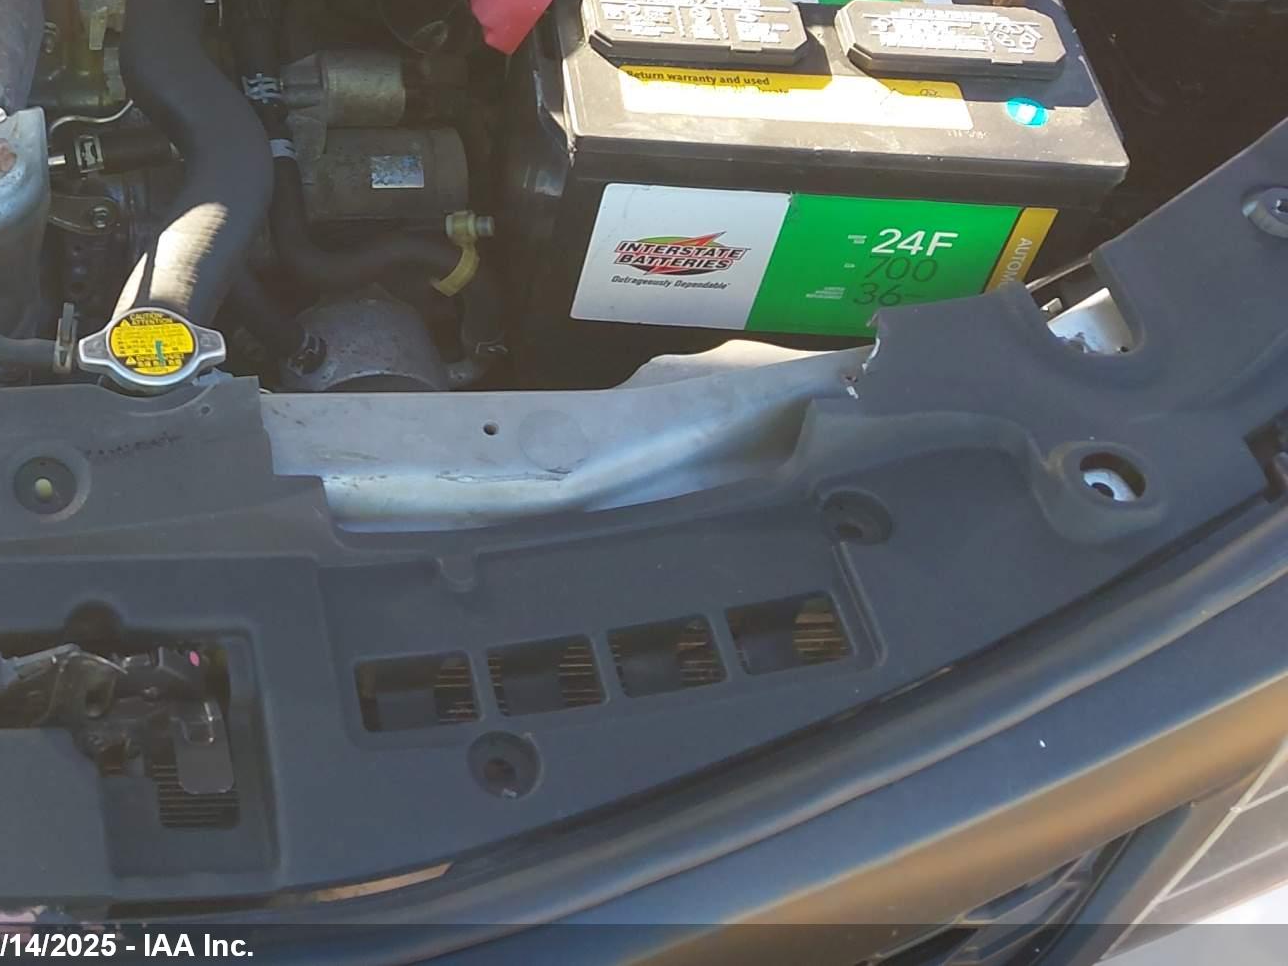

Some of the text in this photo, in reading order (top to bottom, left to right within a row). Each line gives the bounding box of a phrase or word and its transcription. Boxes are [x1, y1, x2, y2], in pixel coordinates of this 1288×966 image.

[626, 70, 770, 85] Return warranty and used
[617, 242, 743, 259] INTERSTATE
[871, 228, 960, 257] 24F
[618, 255, 732, 269] BATTERIES
[865, 256, 938, 284] 700
[611, 275, 729, 290] Outrageously Dependable
[853, 282, 902, 306] 36
[130, 313, 163, 321] CAUTION
